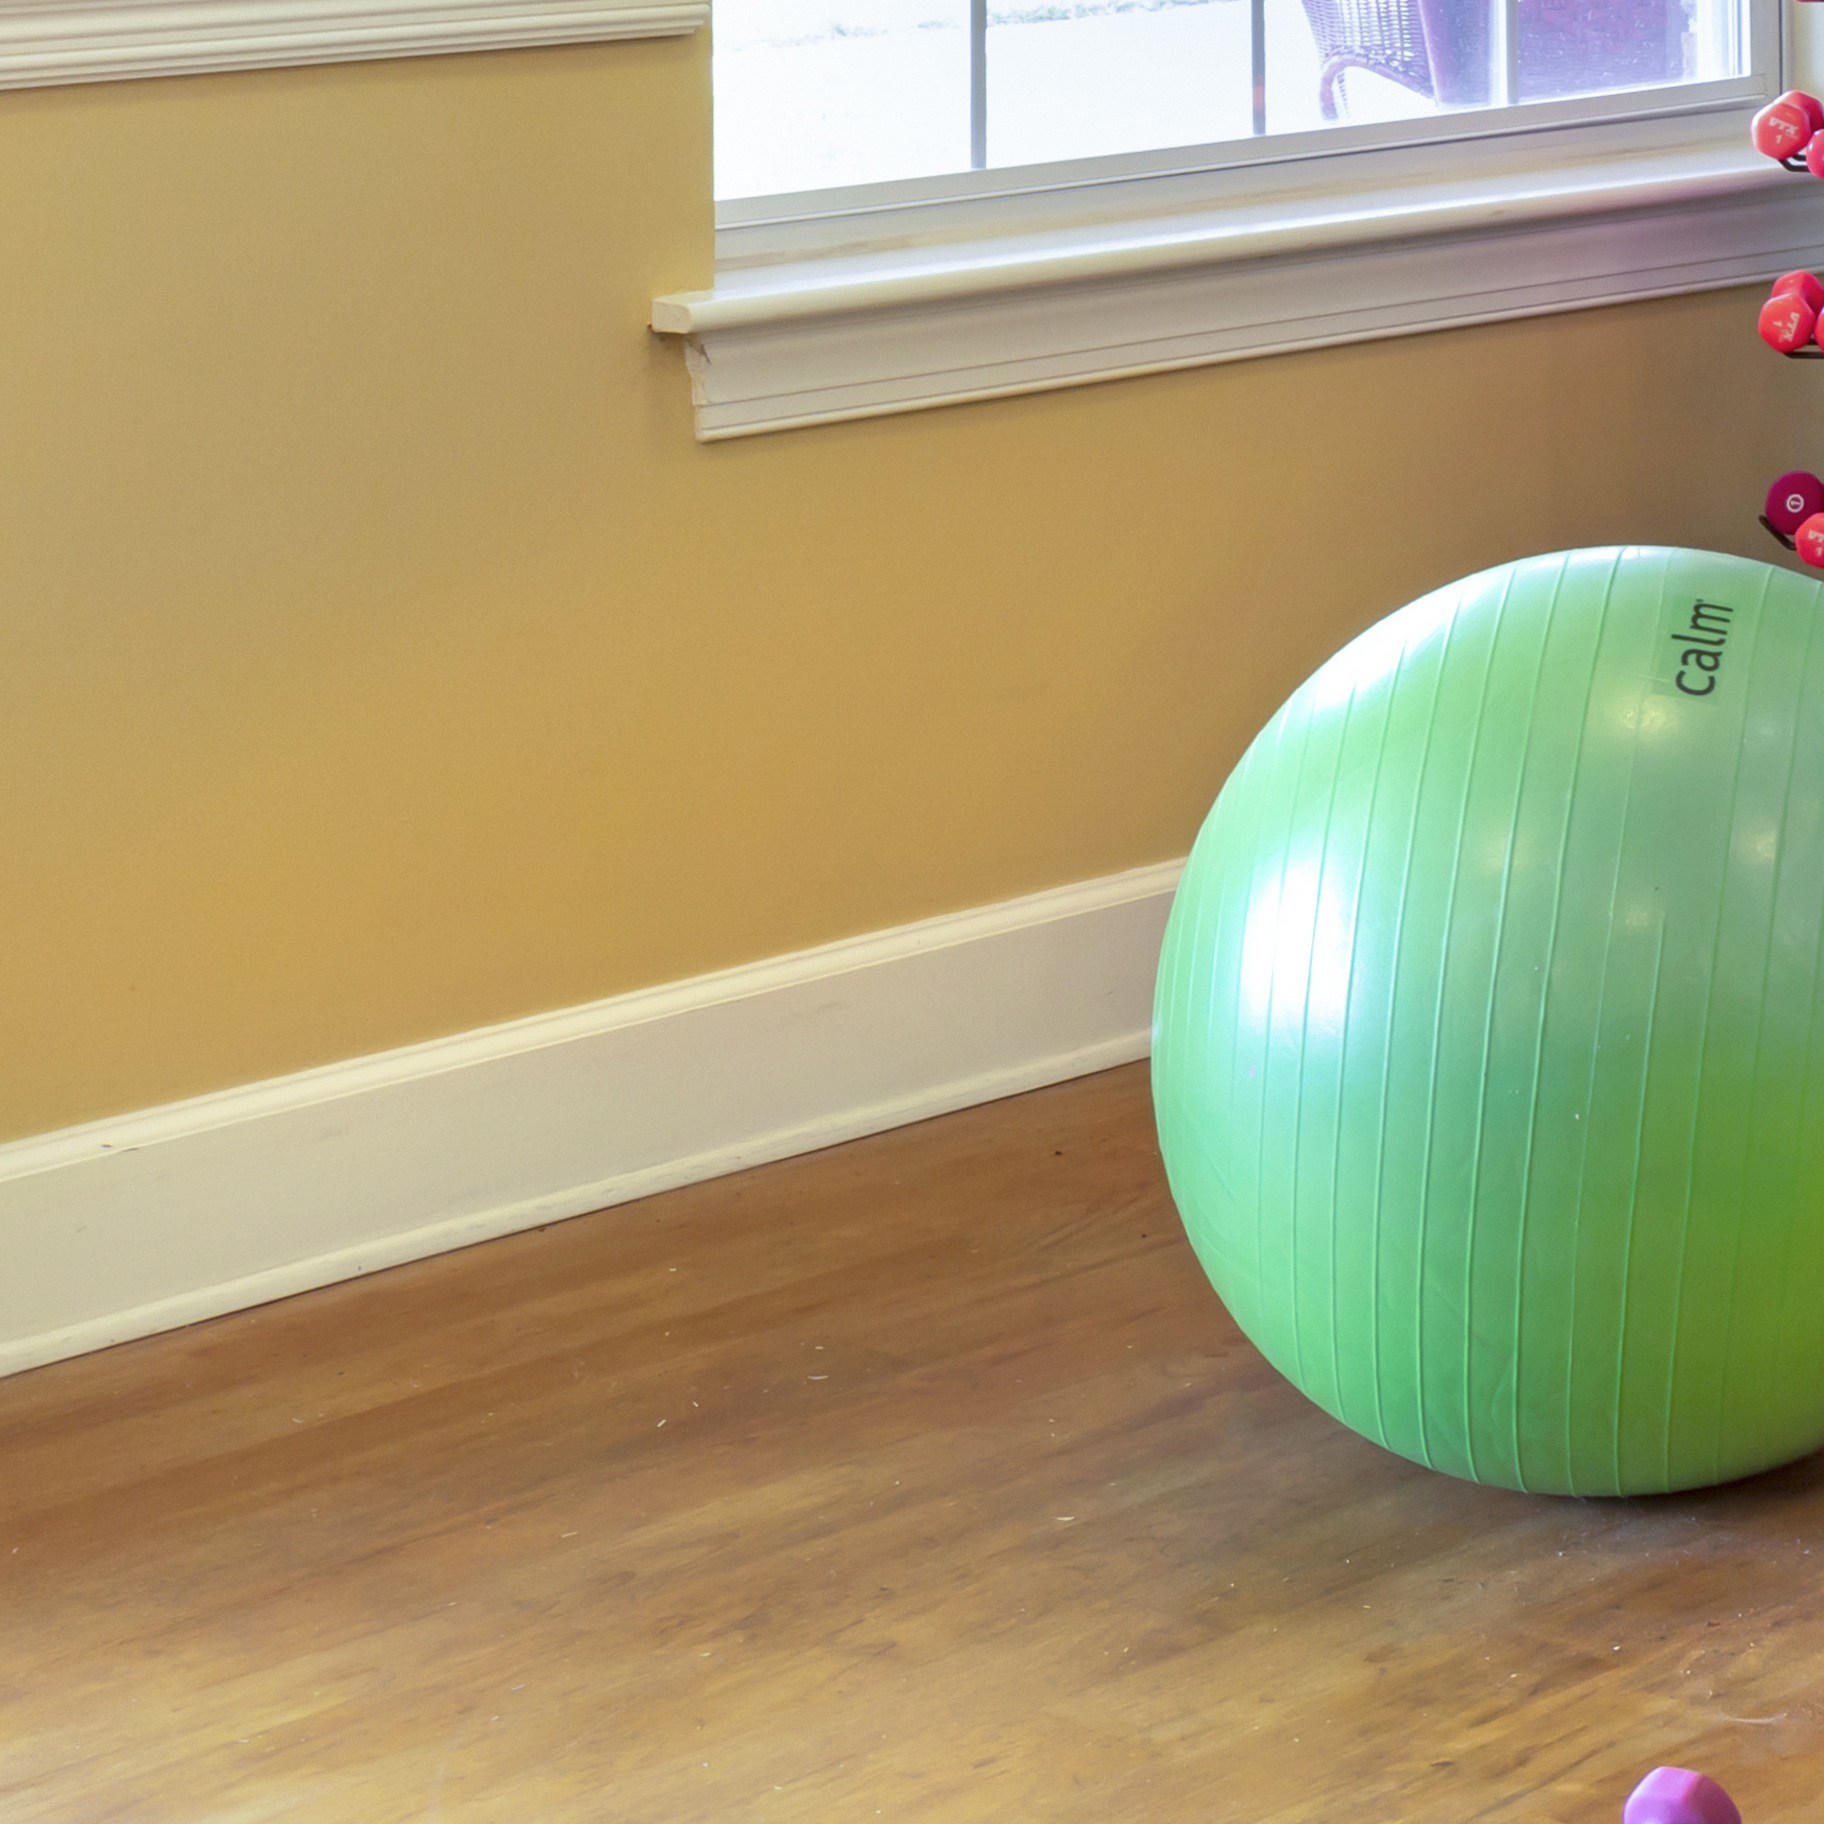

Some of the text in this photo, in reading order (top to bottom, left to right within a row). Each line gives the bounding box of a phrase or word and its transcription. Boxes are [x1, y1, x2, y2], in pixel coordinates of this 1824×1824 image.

[1768, 116, 1799, 136] VTX
[1776, 134, 1783, 145] 1
[1782, 311, 1800, 344] VTX
[1815, 546, 1823, 557] 1
[1671, 601, 1734, 696] calm
